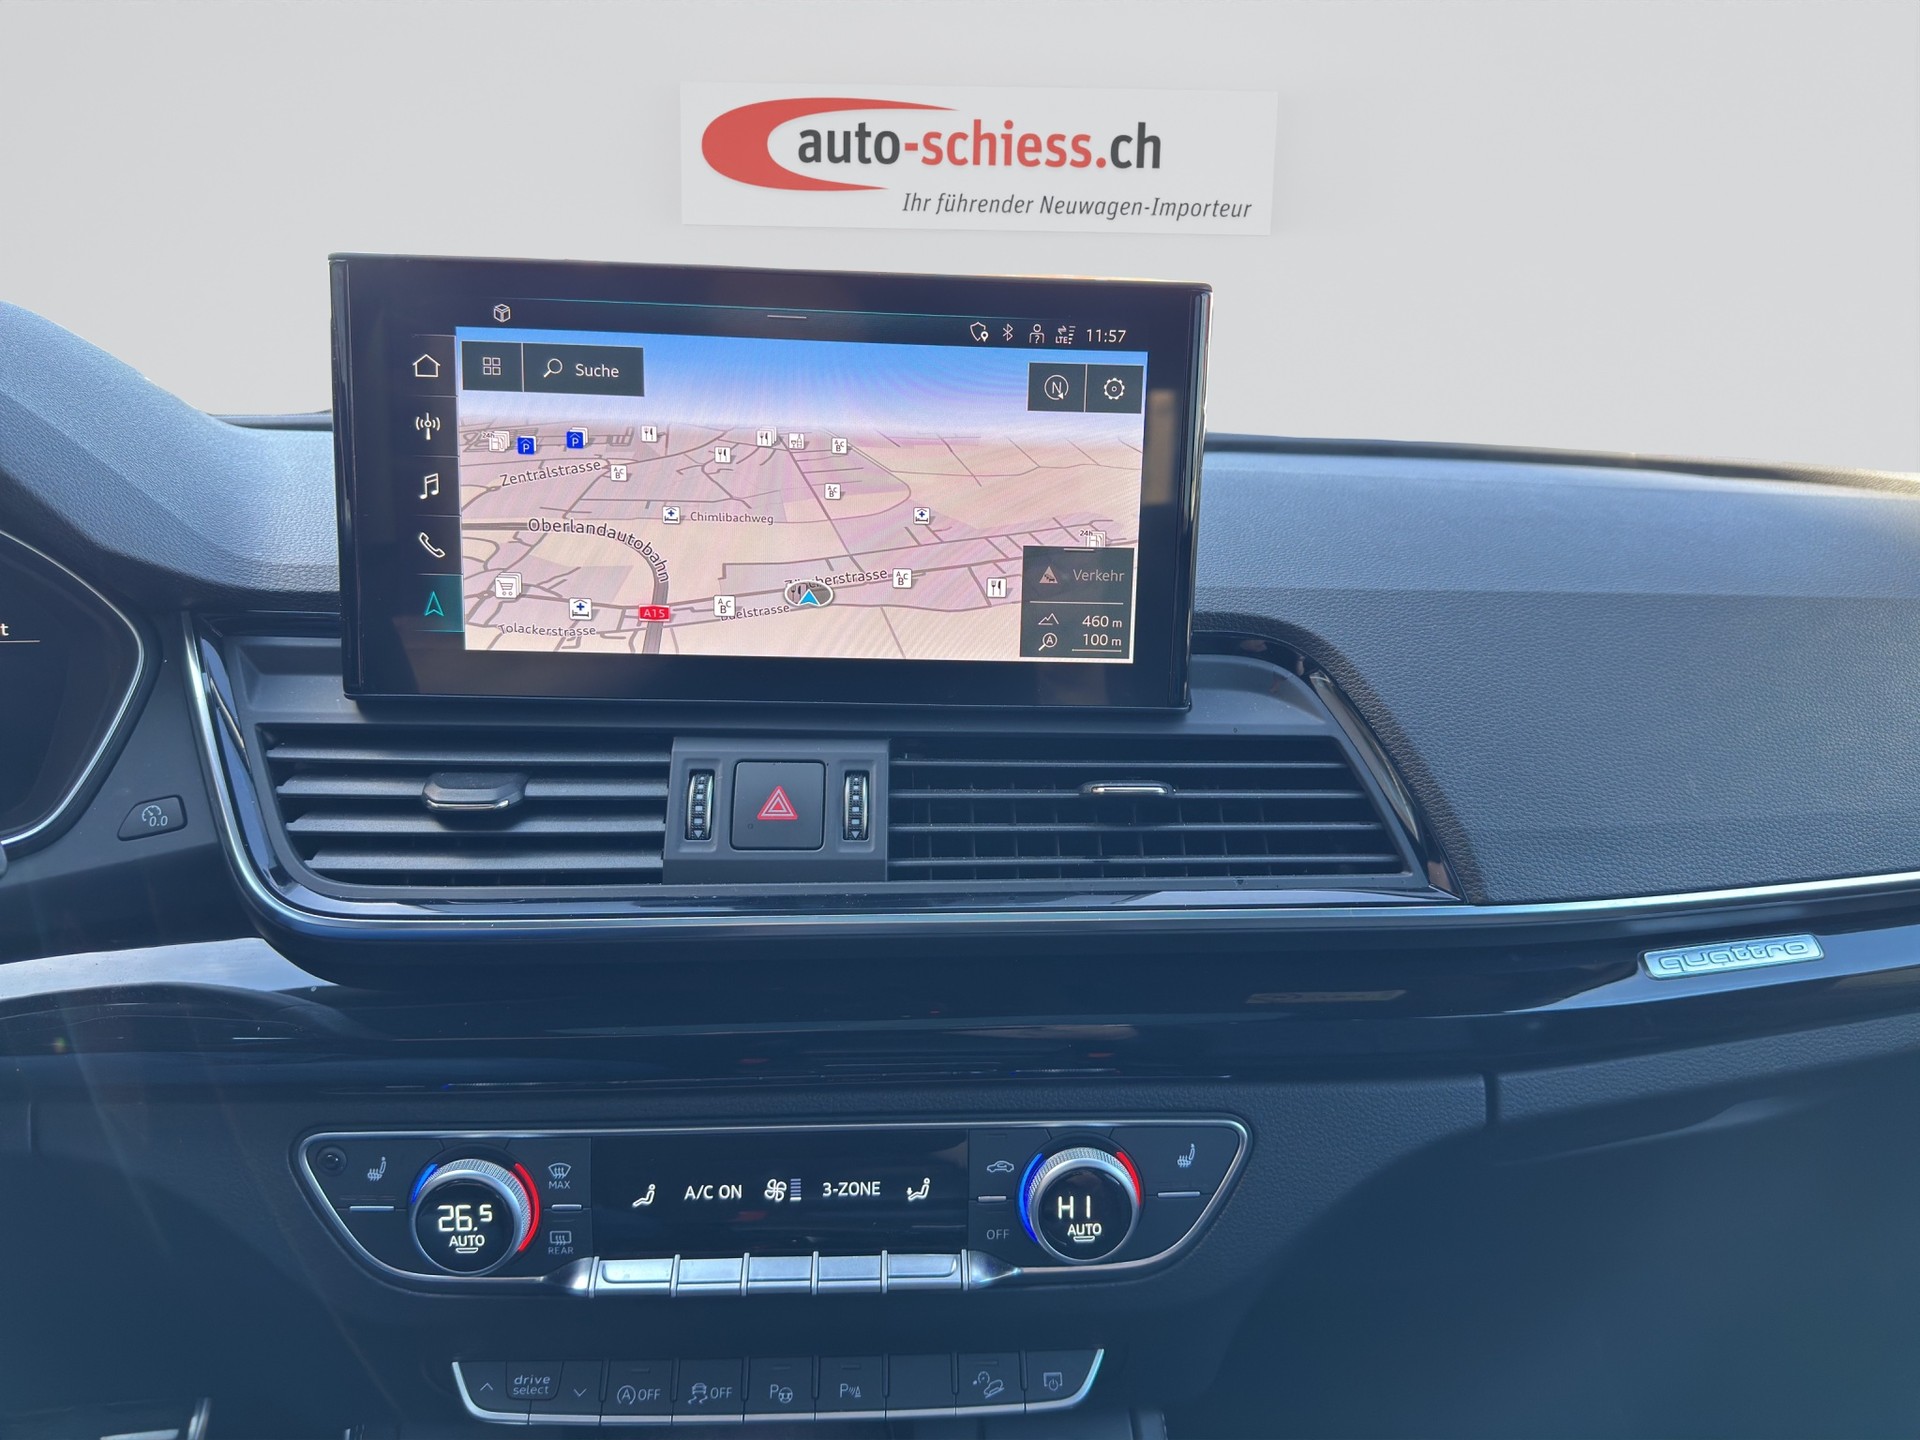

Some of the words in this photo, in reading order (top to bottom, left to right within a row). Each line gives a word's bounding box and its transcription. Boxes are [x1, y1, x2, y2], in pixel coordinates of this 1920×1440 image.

[799, 118, 1161, 170] auto-schiess.ch
[902, 193, 930, 212] Ihr
[935, 193, 1033, 216] führender
[1040, 195, 1253, 221] Neuwagen-Importeur
[1055, 336, 1068, 344] LTE
[1086, 328, 1127, 343] 11:57
[575, 363, 619, 378] Suche
[500, 460, 602, 487] Zentralstrasse
[690, 512, 774, 525] Chimlibachweg
[528, 517, 670, 583] Oberlandautobahn
[1072, 569, 1125, 582] Verkehr
[644, 608, 665, 618] A15
[1082, 616, 1109, 628] 460
[1112, 620, 1123, 628] m
[498, 622, 597, 637] Tolackerstrasse
[1083, 634, 1109, 647] 100
[1111, 639, 1122, 647] m
[149, 814, 169, 827] 0.0
[1658, 940, 1806, 972] quattro
[548, 1180, 571, 1190] MAX
[822, 1182, 881, 1198] 3-ZONE
[684, 1185, 714, 1201] A/C
[717, 1185, 742, 1200] ON
[986, 1228, 1010, 1242] OFF
[1067, 1223, 1101, 1236] AUTO
[449, 1234, 486, 1247] AUTO
[548, 1246, 574, 1255] REAR
[514, 1374, 550, 1386] drive
[513, 1385, 549, 1395] select
[638, 1388, 660, 1401] OFF
[710, 1387, 732, 1399] OFF
